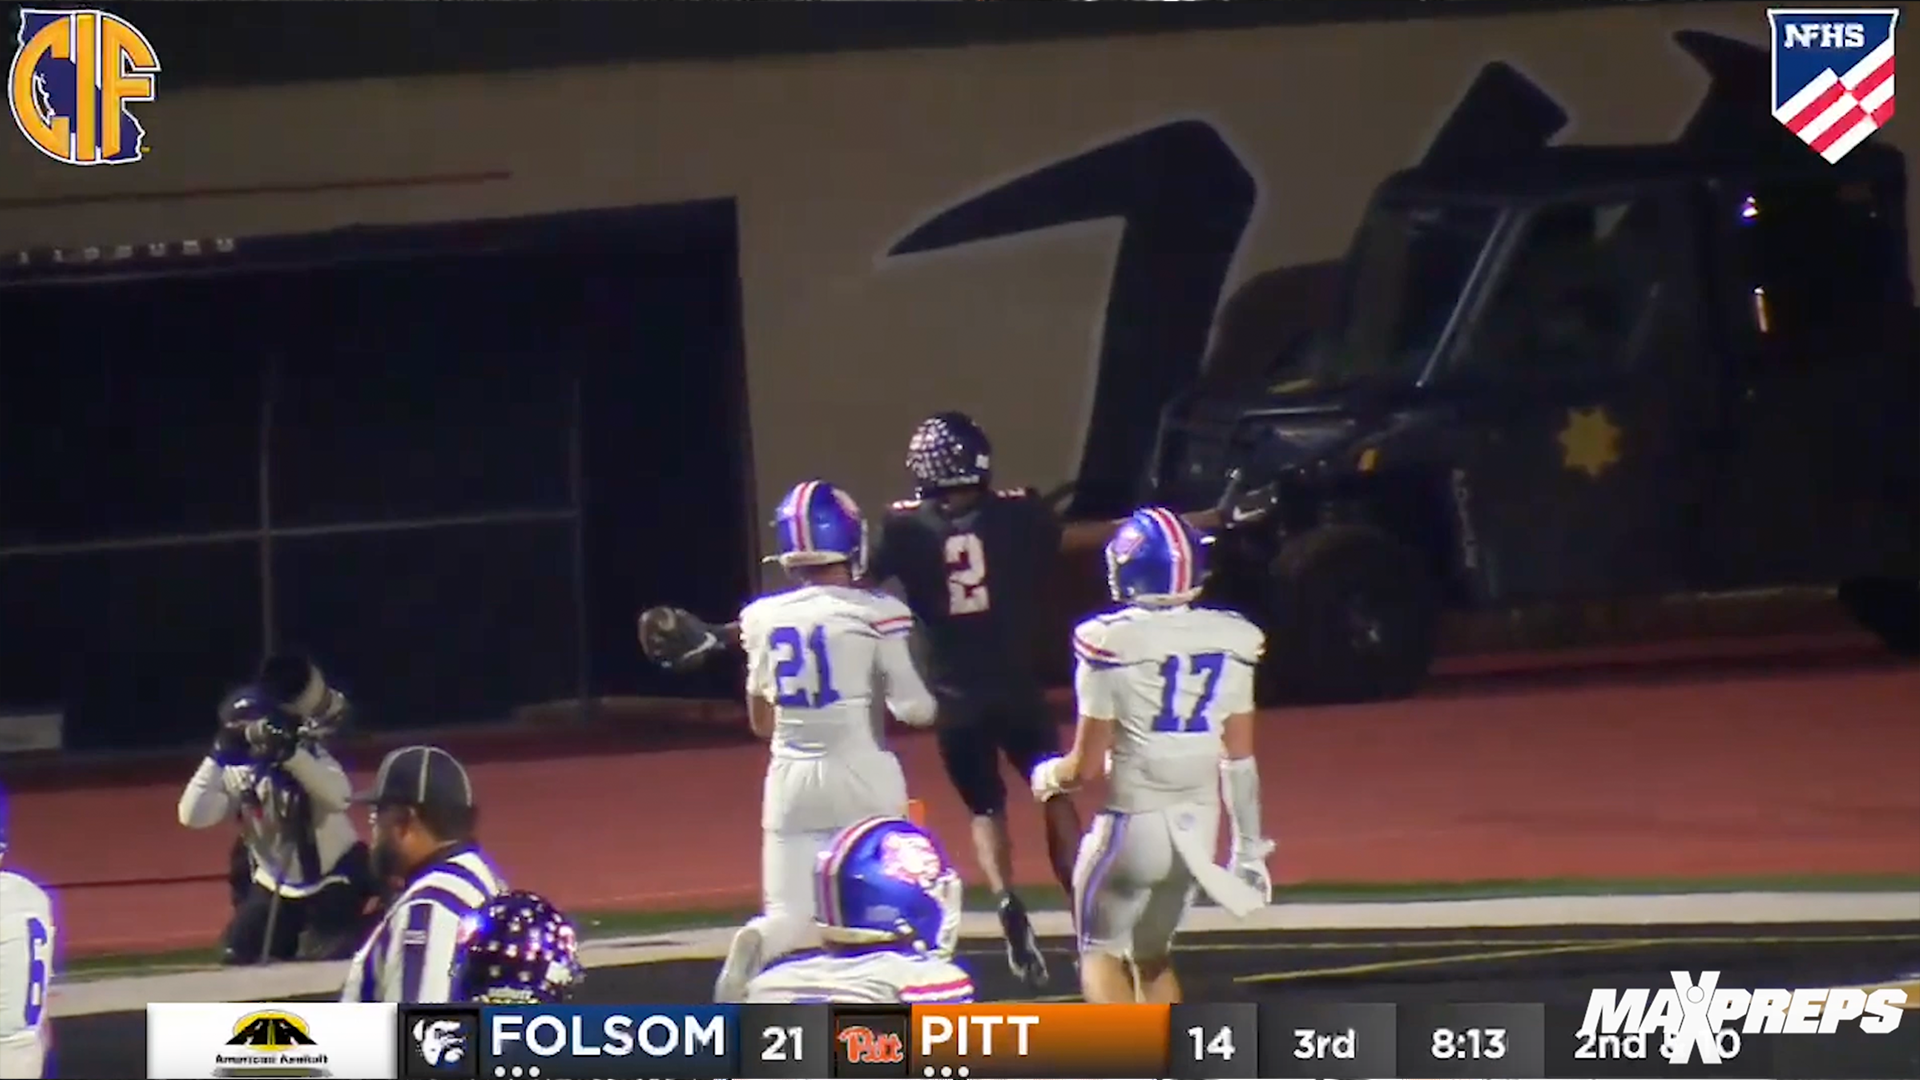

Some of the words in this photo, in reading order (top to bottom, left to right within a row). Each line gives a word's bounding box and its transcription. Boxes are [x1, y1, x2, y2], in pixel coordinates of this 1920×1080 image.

[945, 533, 990, 615] 2
[769, 625, 840, 708] 21
[1150, 653, 1225, 732] 17
[25, 917, 47, 1026] 6
